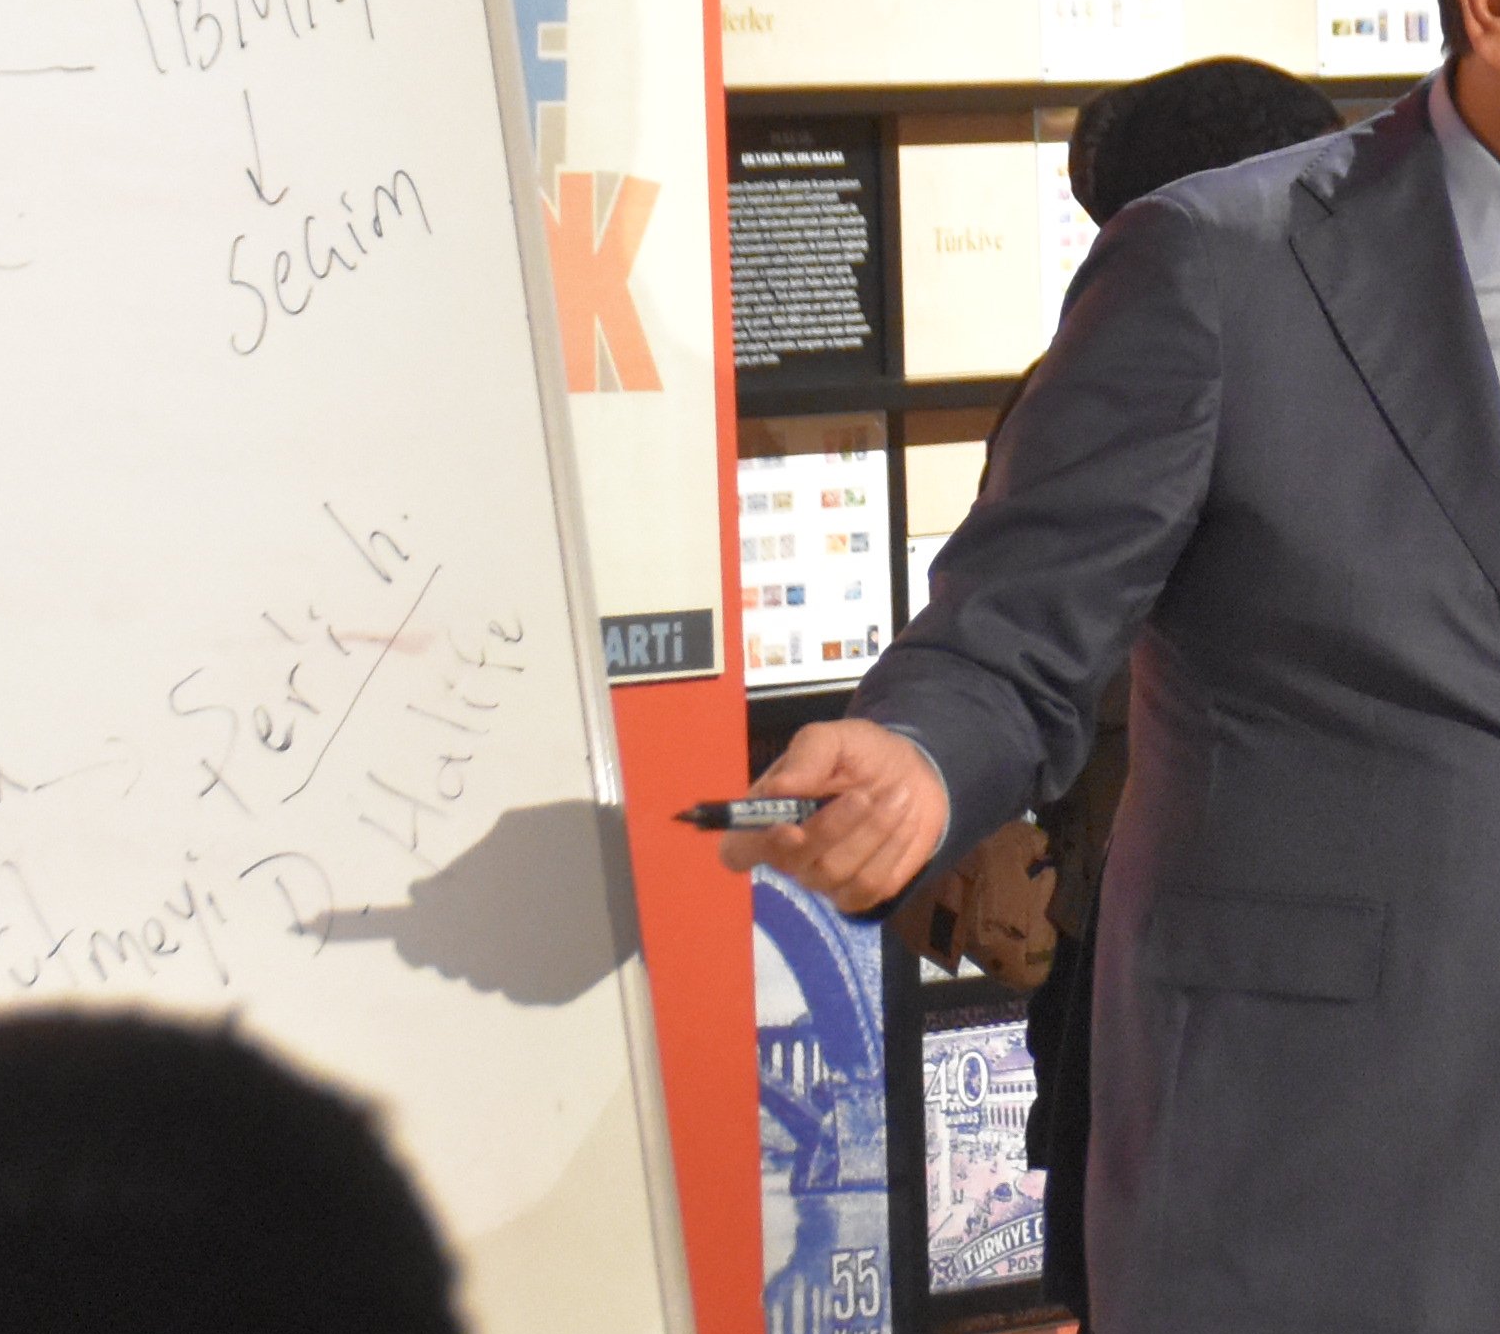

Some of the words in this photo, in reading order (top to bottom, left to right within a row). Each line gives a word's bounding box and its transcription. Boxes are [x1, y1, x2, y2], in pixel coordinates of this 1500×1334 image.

[924, 1050, 990, 1111] 40
[962, 1220, 1031, 1273] TÜRKİYE
[831, 1249, 881, 1321] 55
